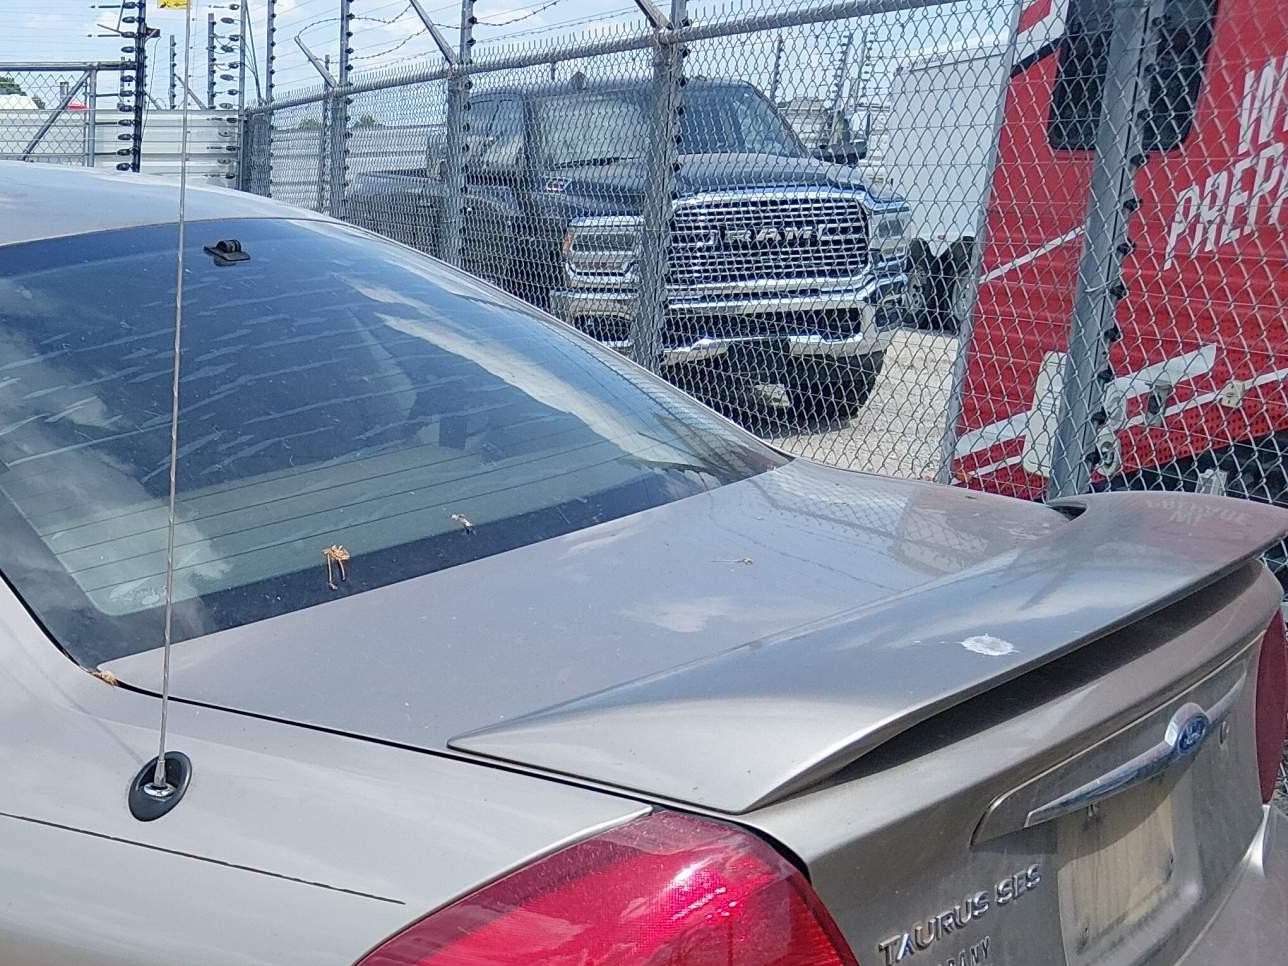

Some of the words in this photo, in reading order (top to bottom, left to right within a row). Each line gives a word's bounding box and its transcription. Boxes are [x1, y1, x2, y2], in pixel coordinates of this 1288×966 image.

[1238, 54, 1288, 155] W
[724, 225, 813, 242] RAM
[995, 864, 1042, 905] SES
